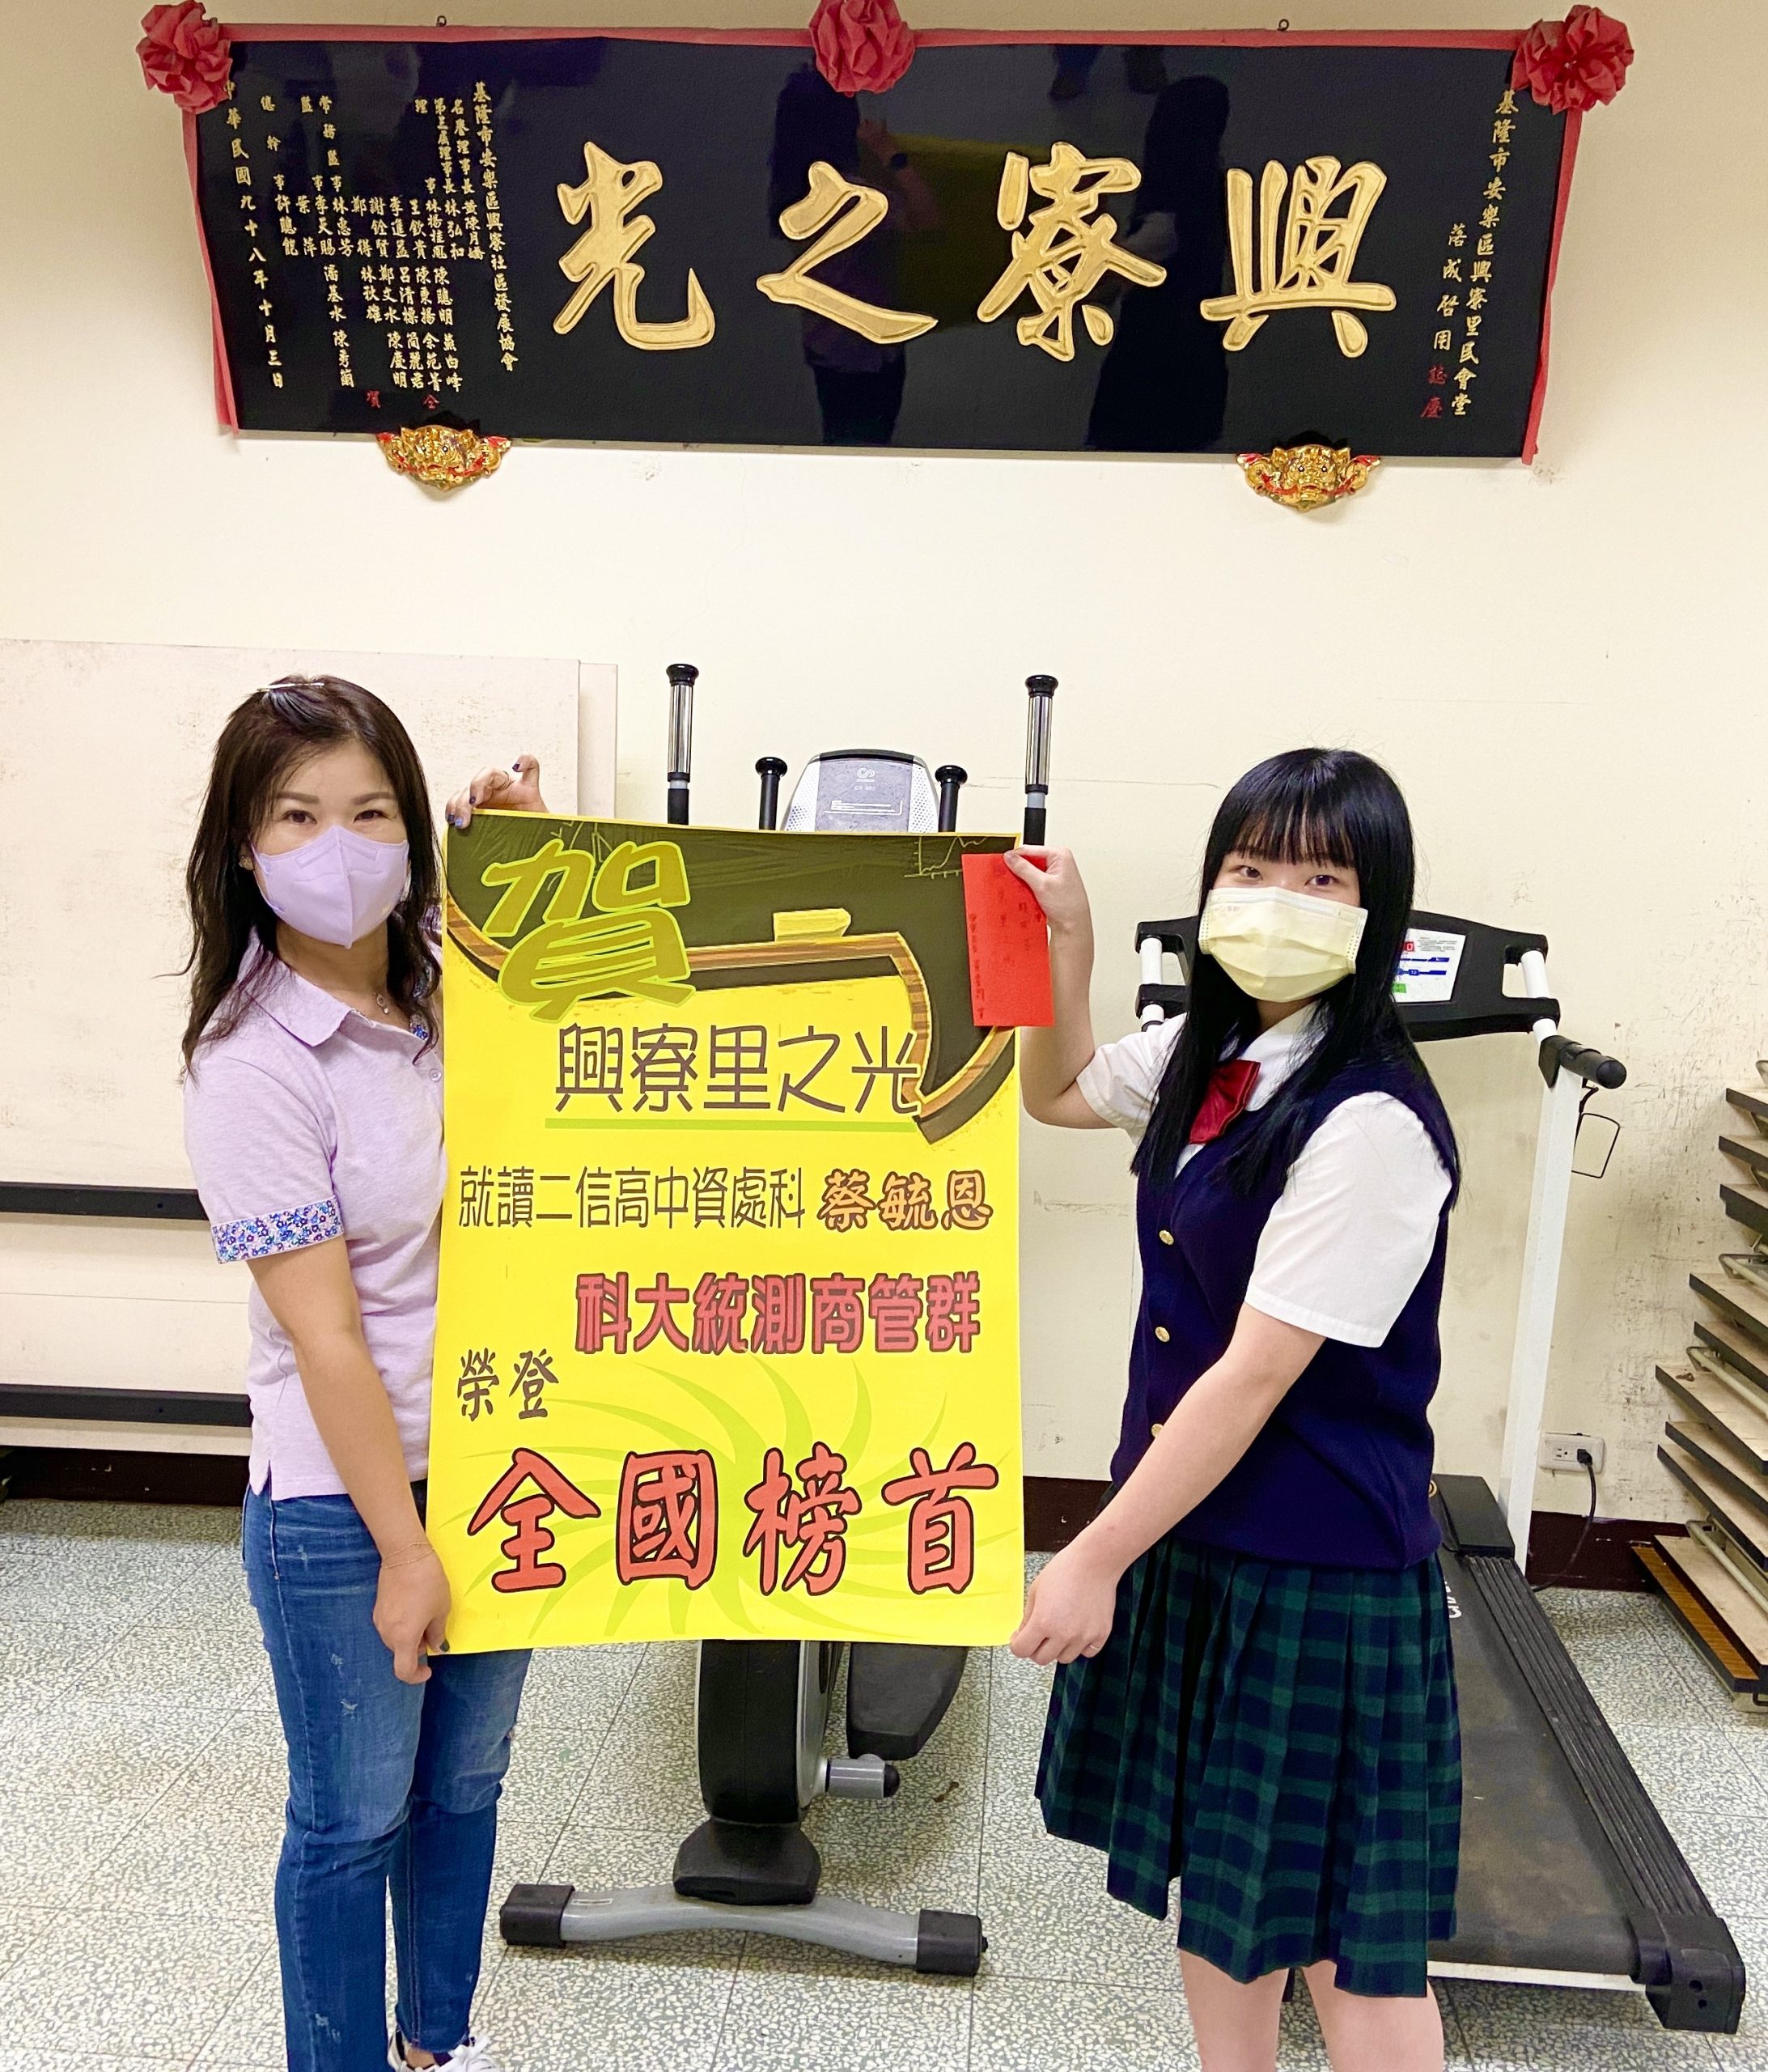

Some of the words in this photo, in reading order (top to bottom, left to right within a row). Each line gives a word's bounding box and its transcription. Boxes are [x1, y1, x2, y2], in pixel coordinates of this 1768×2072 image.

[223, 80, 284, 389] 中華民國九十八年十月三日
[473, 81, 519, 372] 基隆市安樂區興寮社區發展協會
[1451, 89, 1520, 416] 基隆市安樂區興寮里民會堂
[481, 839, 696, 1023] 賀
[554, 1023, 922, 1115] 興寮里之光
[458, 1164, 807, 1230] 就讀二信高中資處科
[816, 1168, 994, 1233] 蔡毓恩
[456, 1347, 560, 1422] 榮登
[574, 1271, 982, 1355] 科大統測商管群
[467, 1441, 999, 1597] 全國榜首
